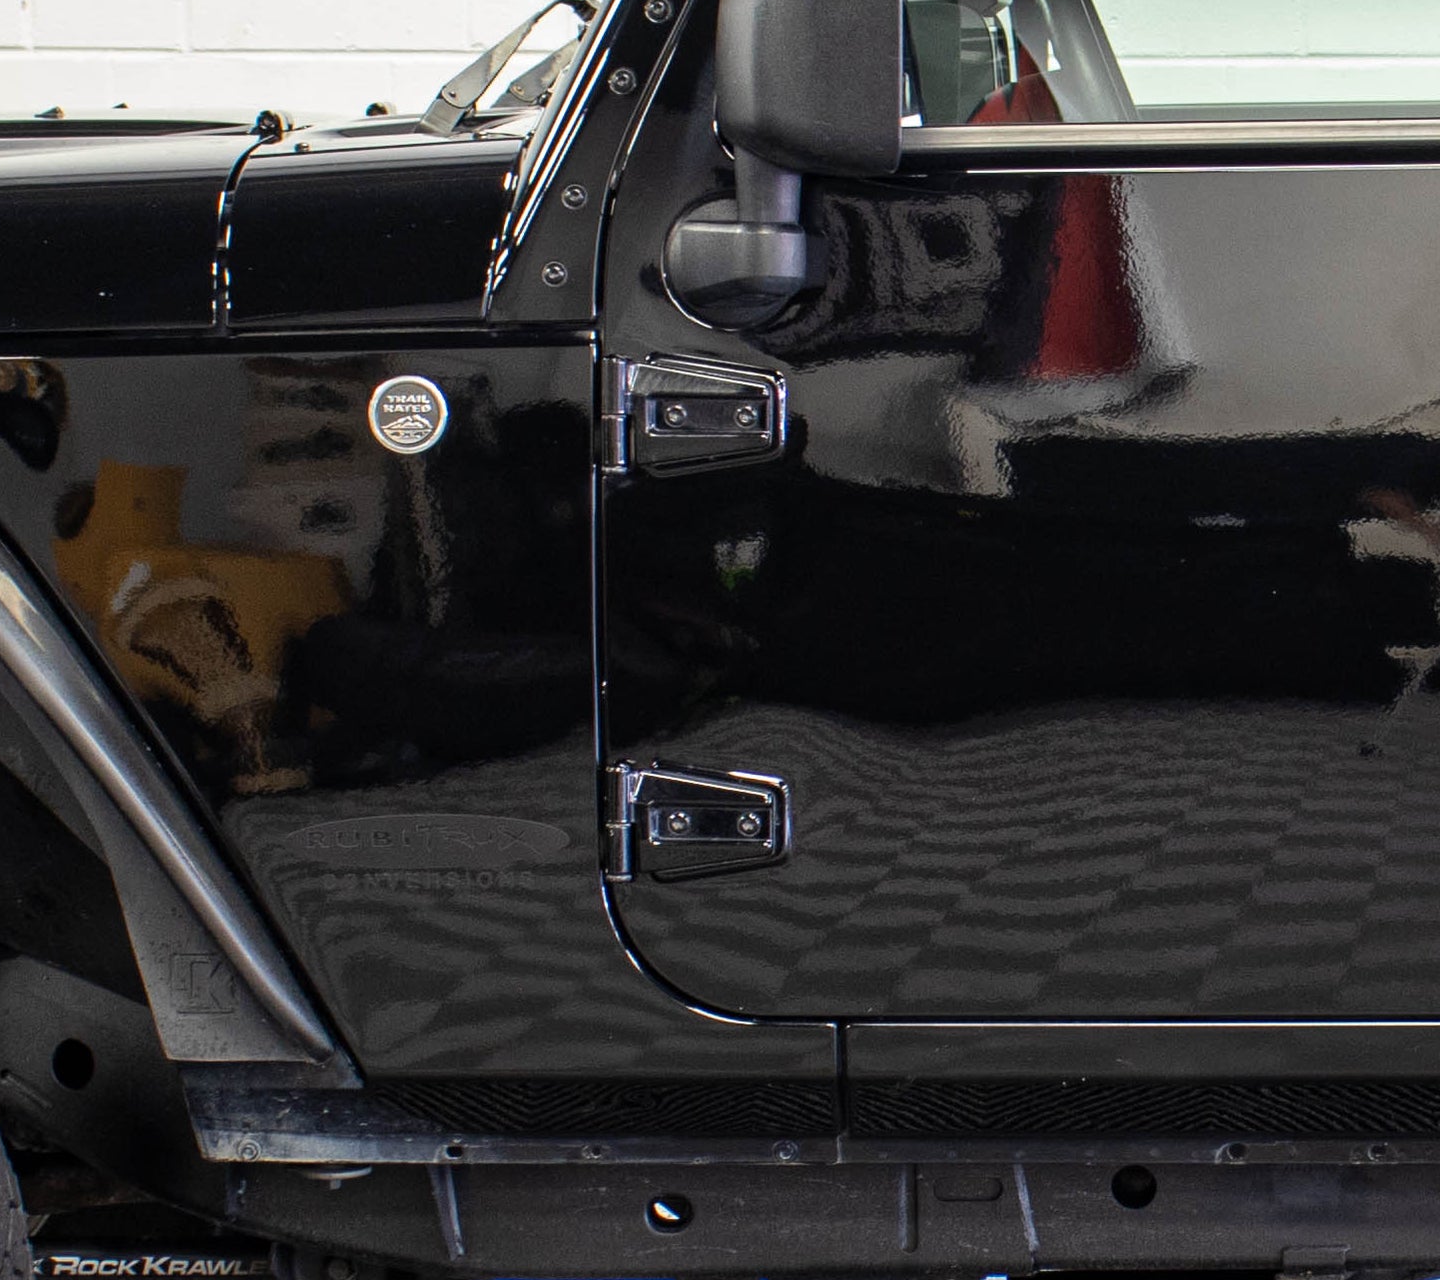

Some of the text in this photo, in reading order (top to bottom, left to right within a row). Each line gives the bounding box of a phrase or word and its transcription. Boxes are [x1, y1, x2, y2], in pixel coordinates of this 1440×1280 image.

[387, 394, 430, 404] TRAIL
[382, 404, 432, 413] RATED
[49, 1256, 268, 1276] ROCK KRAWLE
